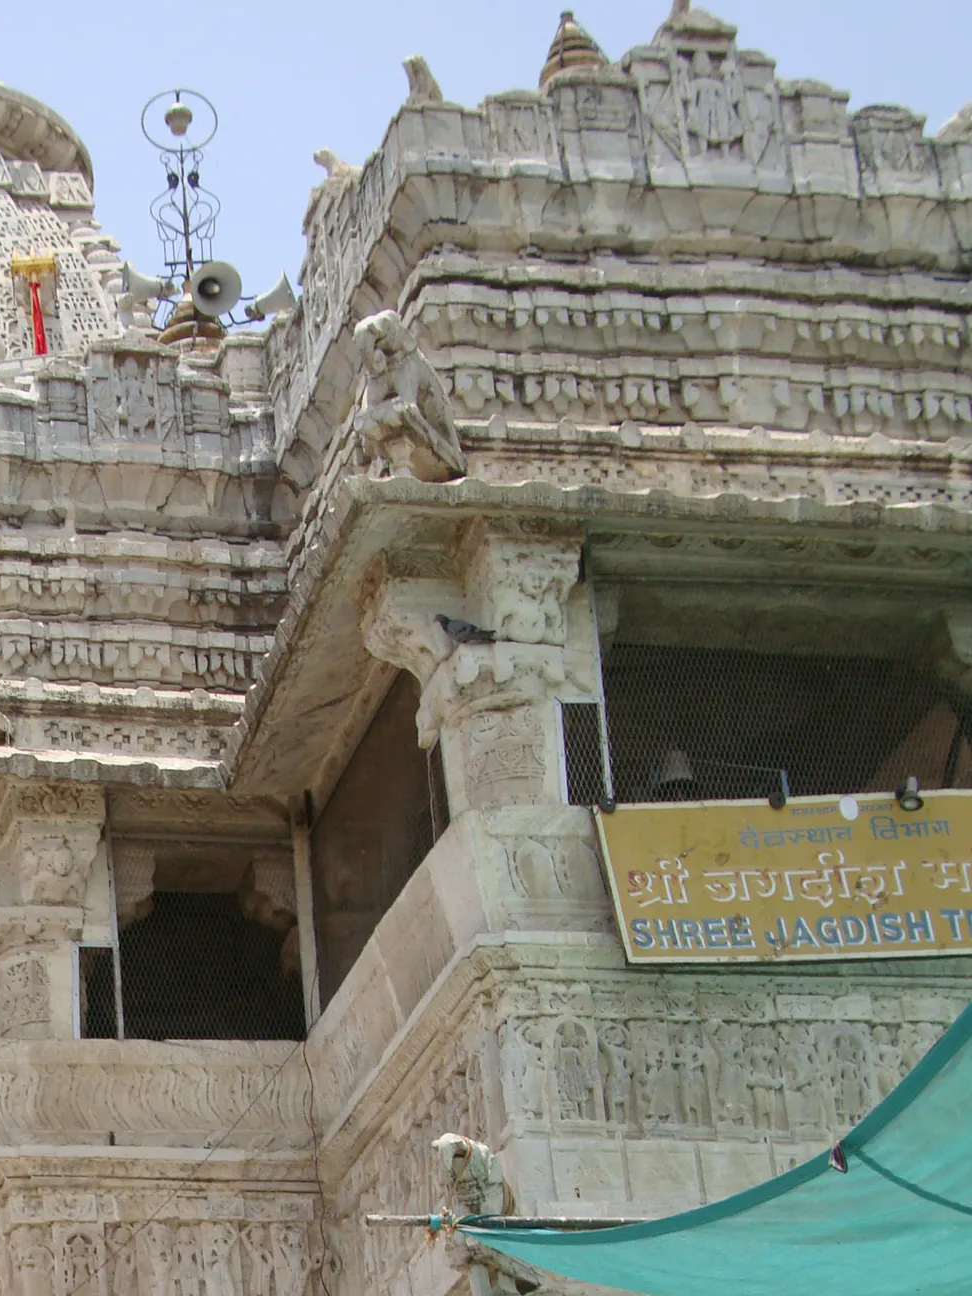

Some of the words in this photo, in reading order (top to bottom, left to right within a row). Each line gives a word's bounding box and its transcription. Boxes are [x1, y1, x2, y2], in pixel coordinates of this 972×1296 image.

[738, 824, 853, 850] देवस्थान
[870, 815, 951, 840] विभाग
[627, 856, 690, 908] श्री
[702, 850, 907, 908] जगदीश
[630, 916, 756, 950] SHREE
[763, 909, 935, 949] JAGDISH
